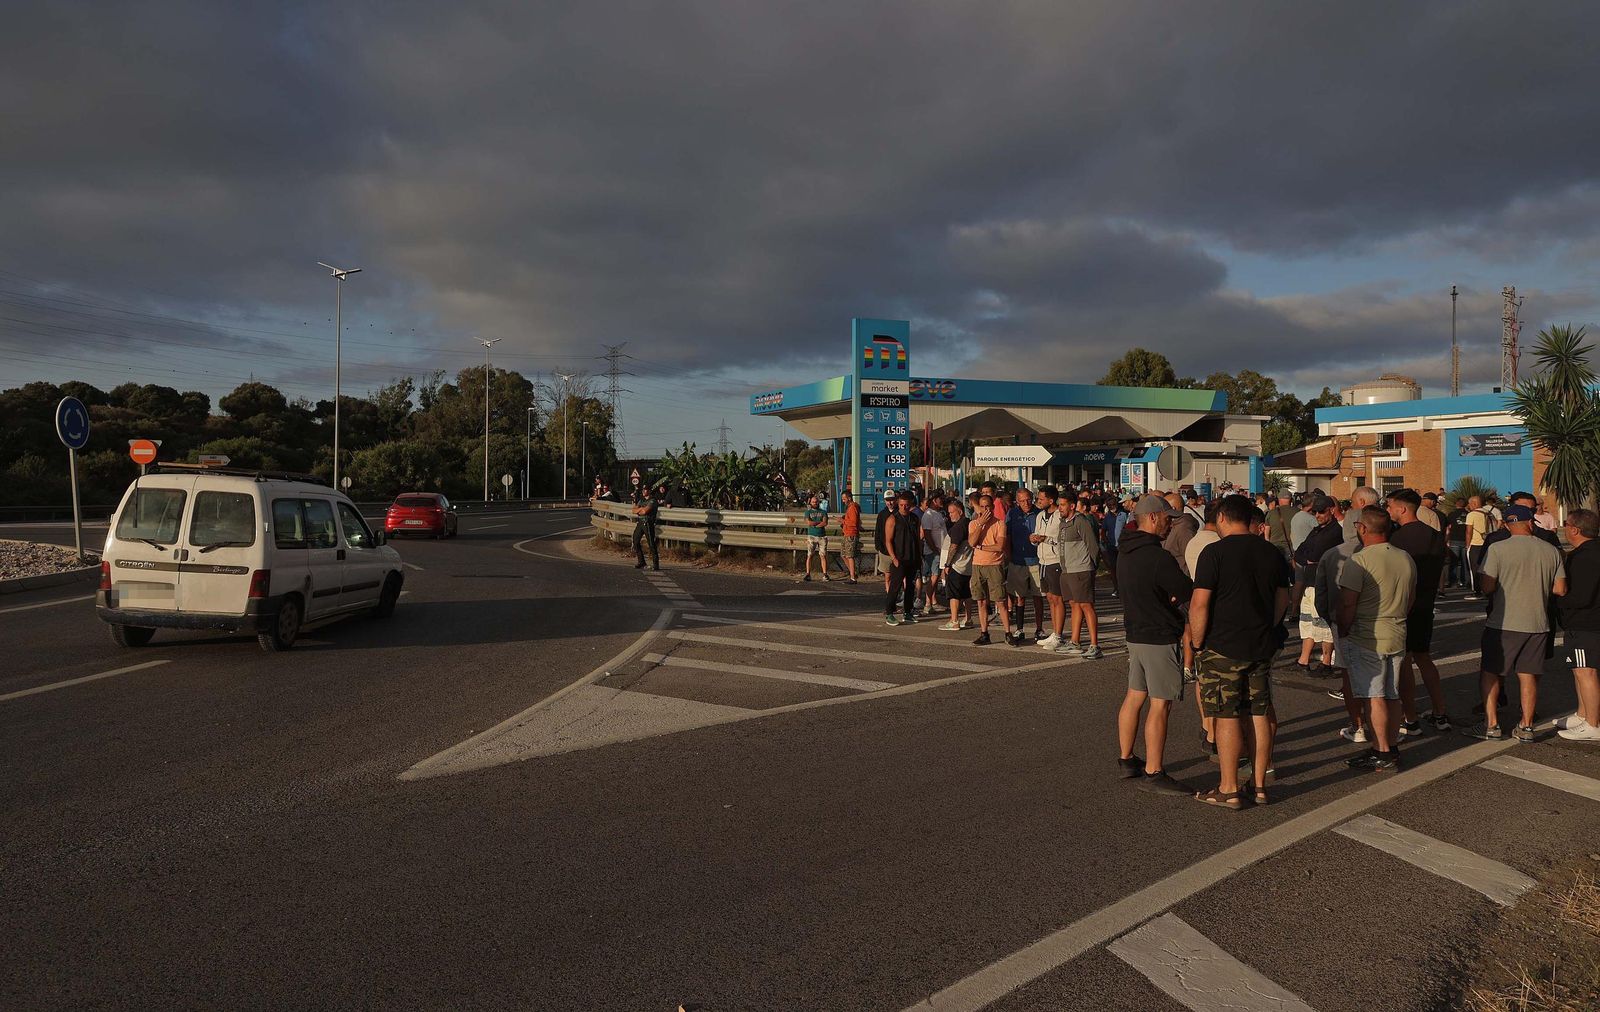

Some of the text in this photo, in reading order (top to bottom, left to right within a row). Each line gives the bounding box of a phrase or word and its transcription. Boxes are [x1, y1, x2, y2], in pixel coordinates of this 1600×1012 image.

[871, 385, 899, 393] market
[908, 380, 957, 399] eve
[754, 392, 784, 411] moeve
[887, 426, 905, 435] 1.506
[887, 440, 905, 449] 1.532
[887, 455, 905, 463] 1.592
[1084, 453, 1106, 461] moeve
[887, 469, 905, 477] 1.582
[119, 560, 156, 568] CITROËN
[212, 566, 242, 574] Berlingo
